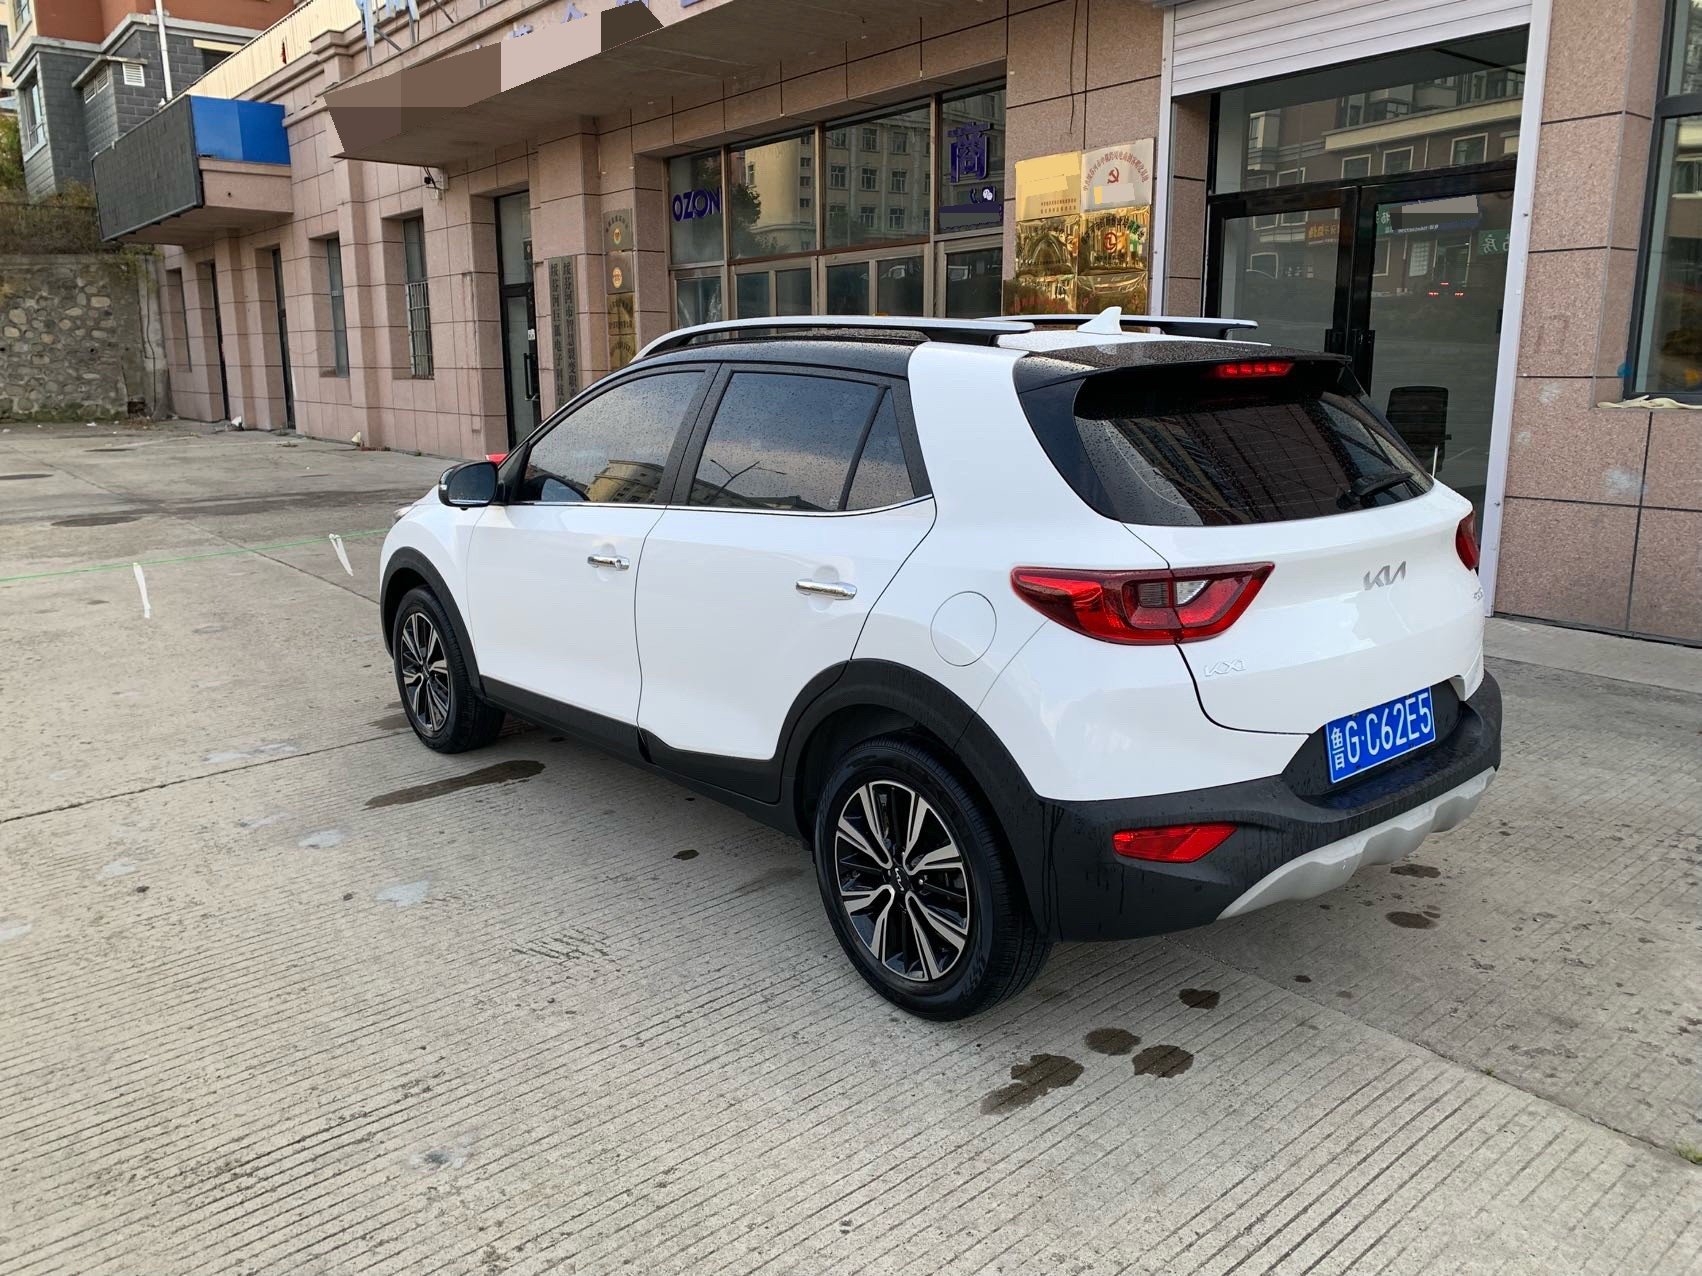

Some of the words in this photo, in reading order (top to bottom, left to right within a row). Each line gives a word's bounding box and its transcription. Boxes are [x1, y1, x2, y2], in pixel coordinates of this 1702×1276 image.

[947, 122, 992, 183] 商
[673, 186, 722, 222] OZON
[1363, 561, 1406, 590] KIA
